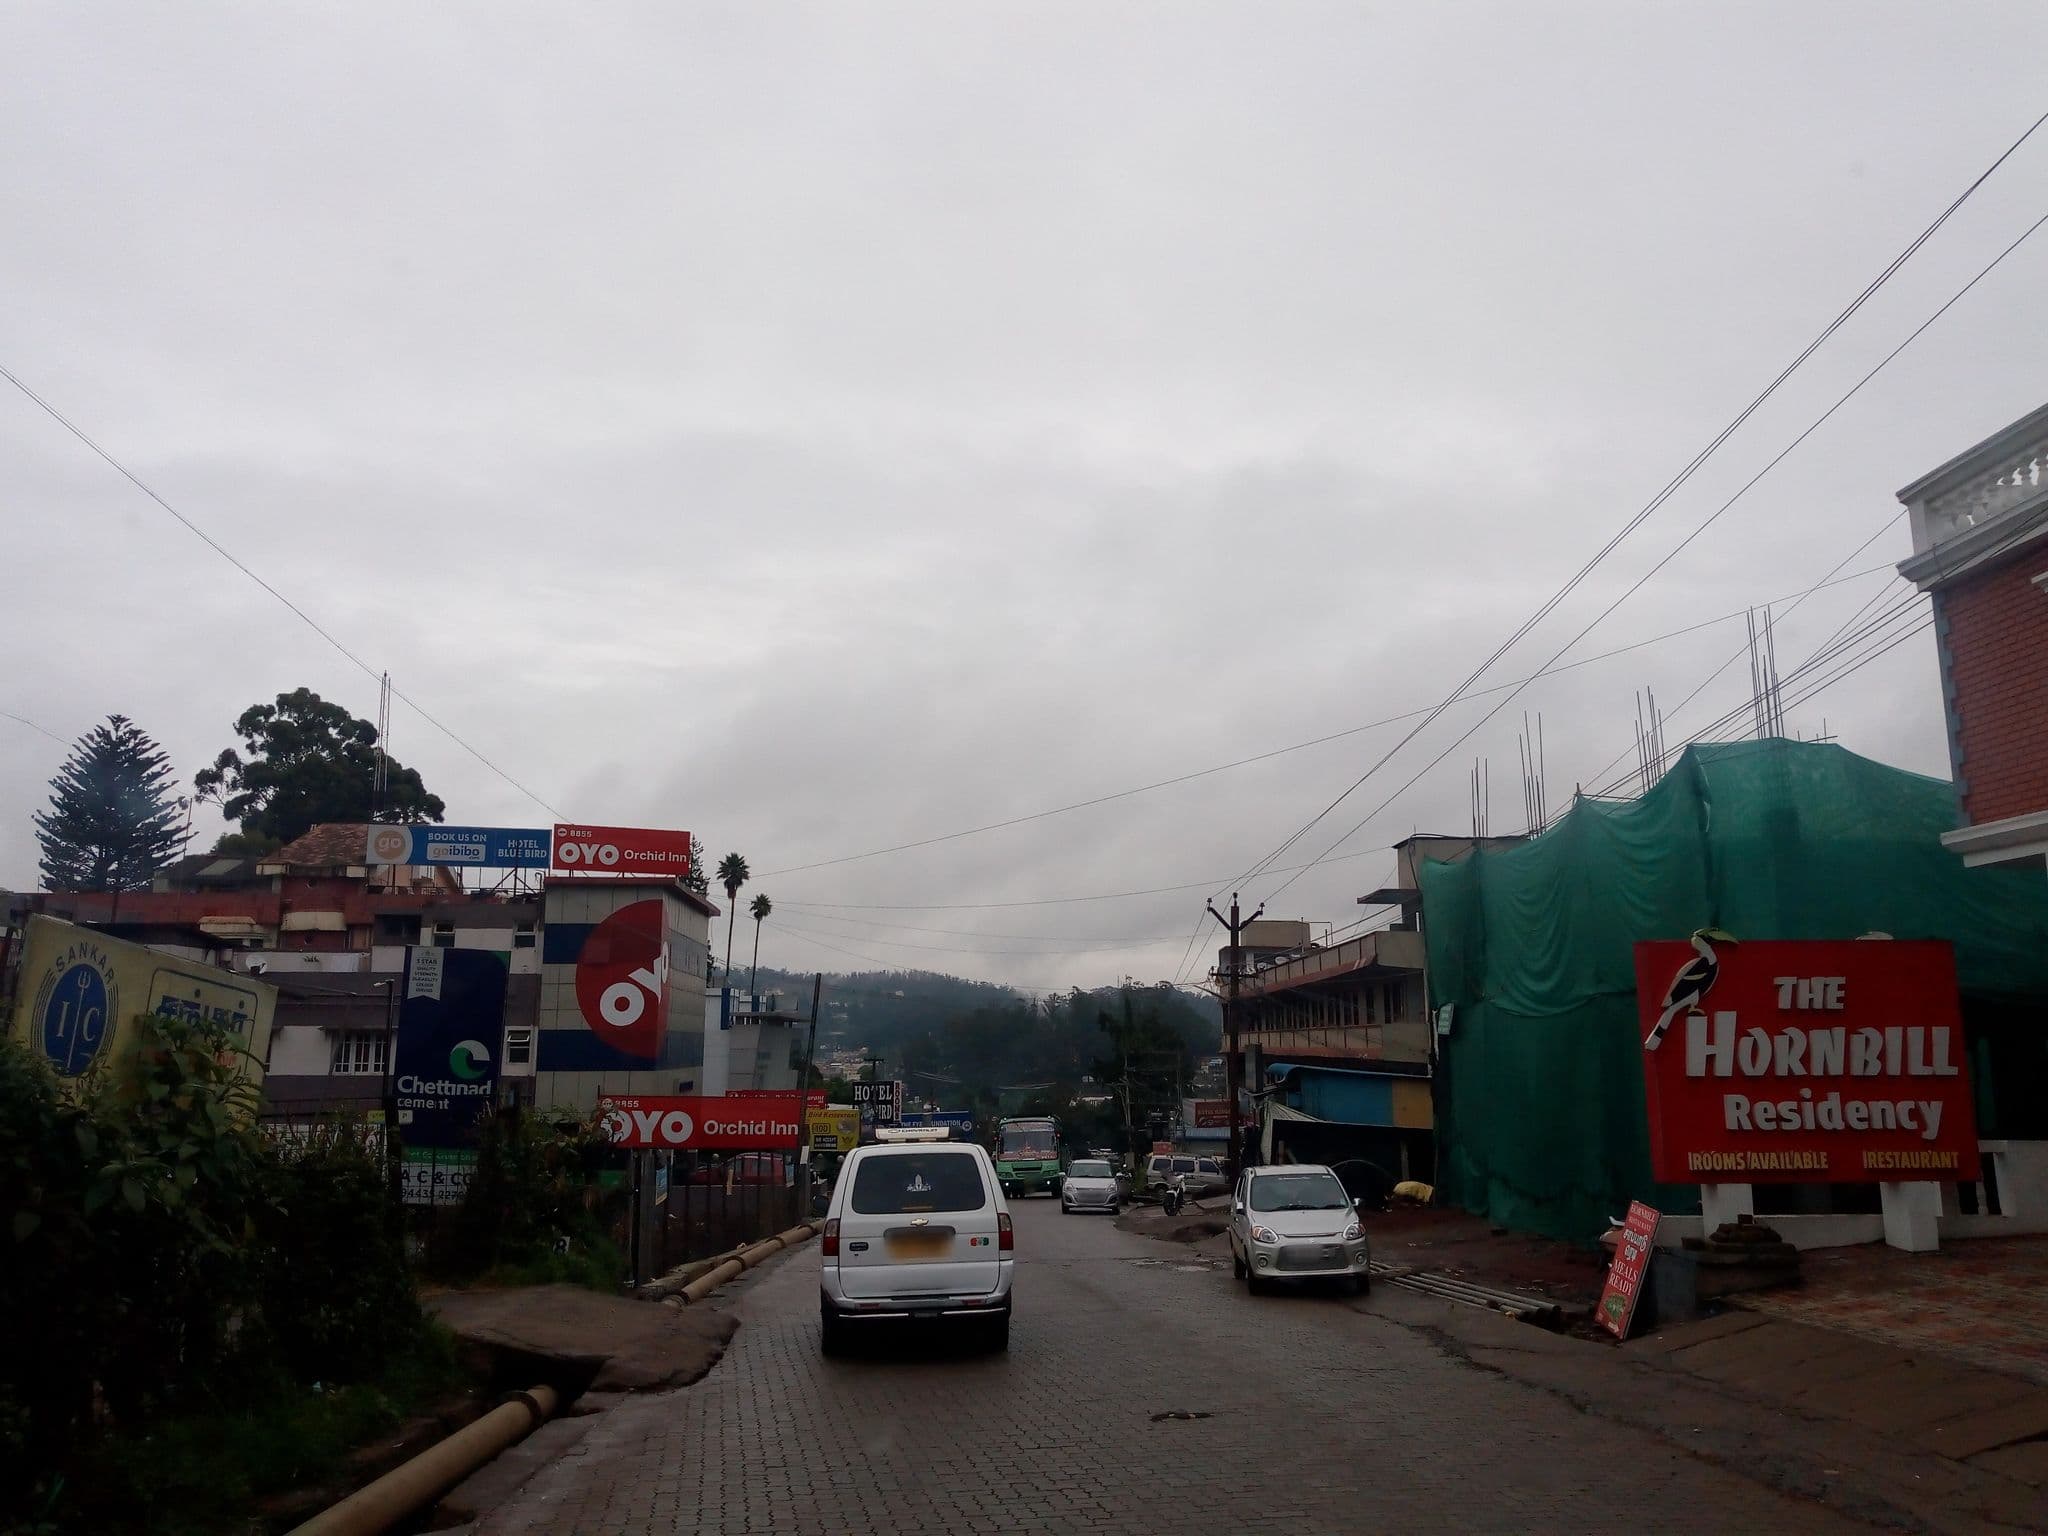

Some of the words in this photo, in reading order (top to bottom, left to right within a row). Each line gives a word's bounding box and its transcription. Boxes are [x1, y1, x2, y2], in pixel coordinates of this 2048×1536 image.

[378, 837, 401, 851] go
[428, 832, 454, 841] BOOK
[458, 833, 470, 842] US
[472, 833, 487, 842] ON
[507, 840, 539, 848] HOTEL
[498, 849, 523, 858] BLUE
[525, 849, 547, 858] BIRD
[558, 842, 620, 866] OYO
[624, 849, 666, 861] Orchid
[668, 851, 687, 862] Inn
[56, 941, 115, 983] SANKAR
[600, 941, 669, 1027] OYO
[1773, 976, 1847, 1010] THE
[1685, 1010, 1960, 1077] HORNBILL
[397, 1075, 492, 1096] Chettinad
[397, 1098, 450, 1110] cement
[876, 1104, 893, 1120] IRD
[1723, 1088, 1943, 1141] Residency
[600, 1110, 694, 1144] OYO
[703, 1119, 766, 1136] Orchid
[770, 1121, 799, 1135] Inn
[931, 1119, 961, 1127] UNDATION
[1688, 1151, 1746, 1170] ROOMS
[1748, 1151, 1829, 1169] AVAILABLE
[1863, 1150, 1960, 1169] RESTAURANT
[433, 1171, 445, 1185] &
[1613, 1259, 1639, 1282] MEALS
[1608, 1272, 1634, 1297] READY
